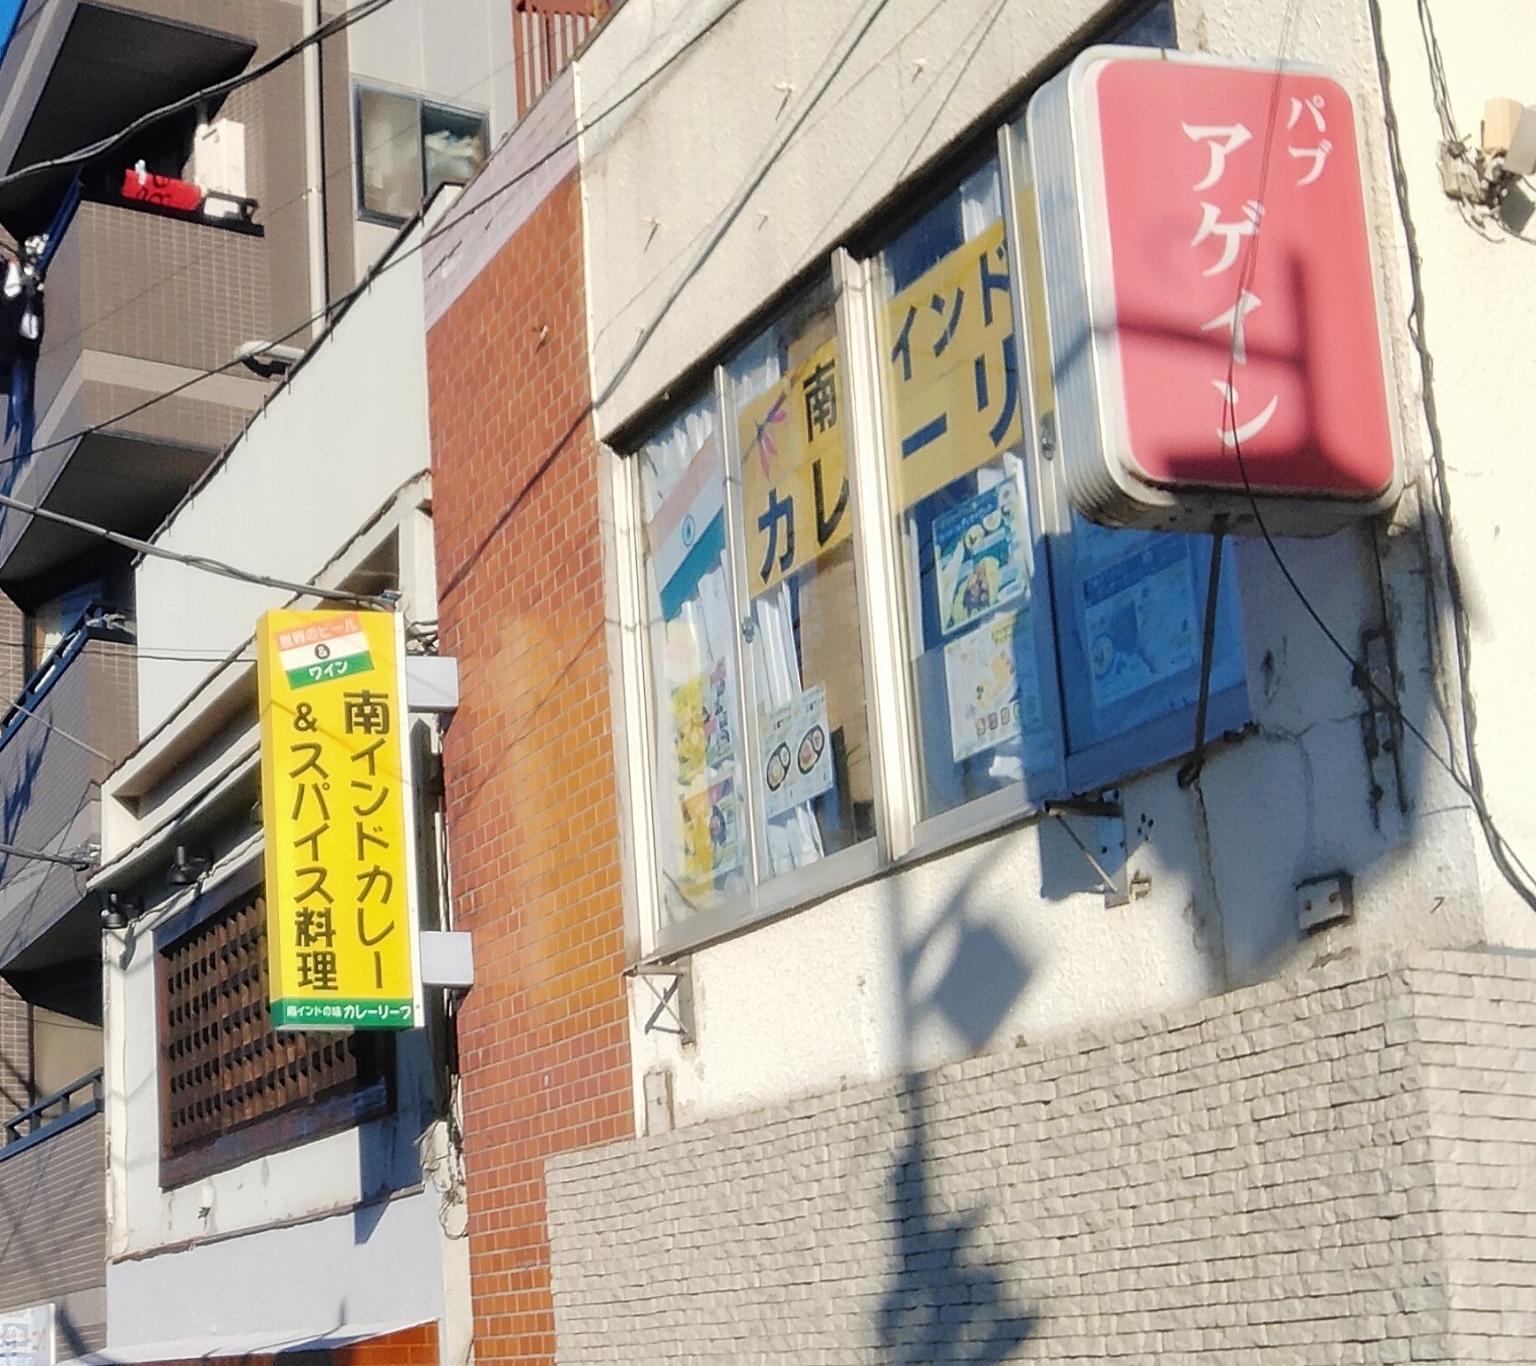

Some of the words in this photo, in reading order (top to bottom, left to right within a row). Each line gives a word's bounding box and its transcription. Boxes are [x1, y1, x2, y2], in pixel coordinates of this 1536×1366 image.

[1283, 93, 1334, 188] パブ
[1180, 119, 1279, 447] アゲイン
[308, 661, 348, 681] ワイン
[343, 688, 396, 990] 南インドカレー
[343, 1005, 412, 1020] カレーリーフ
